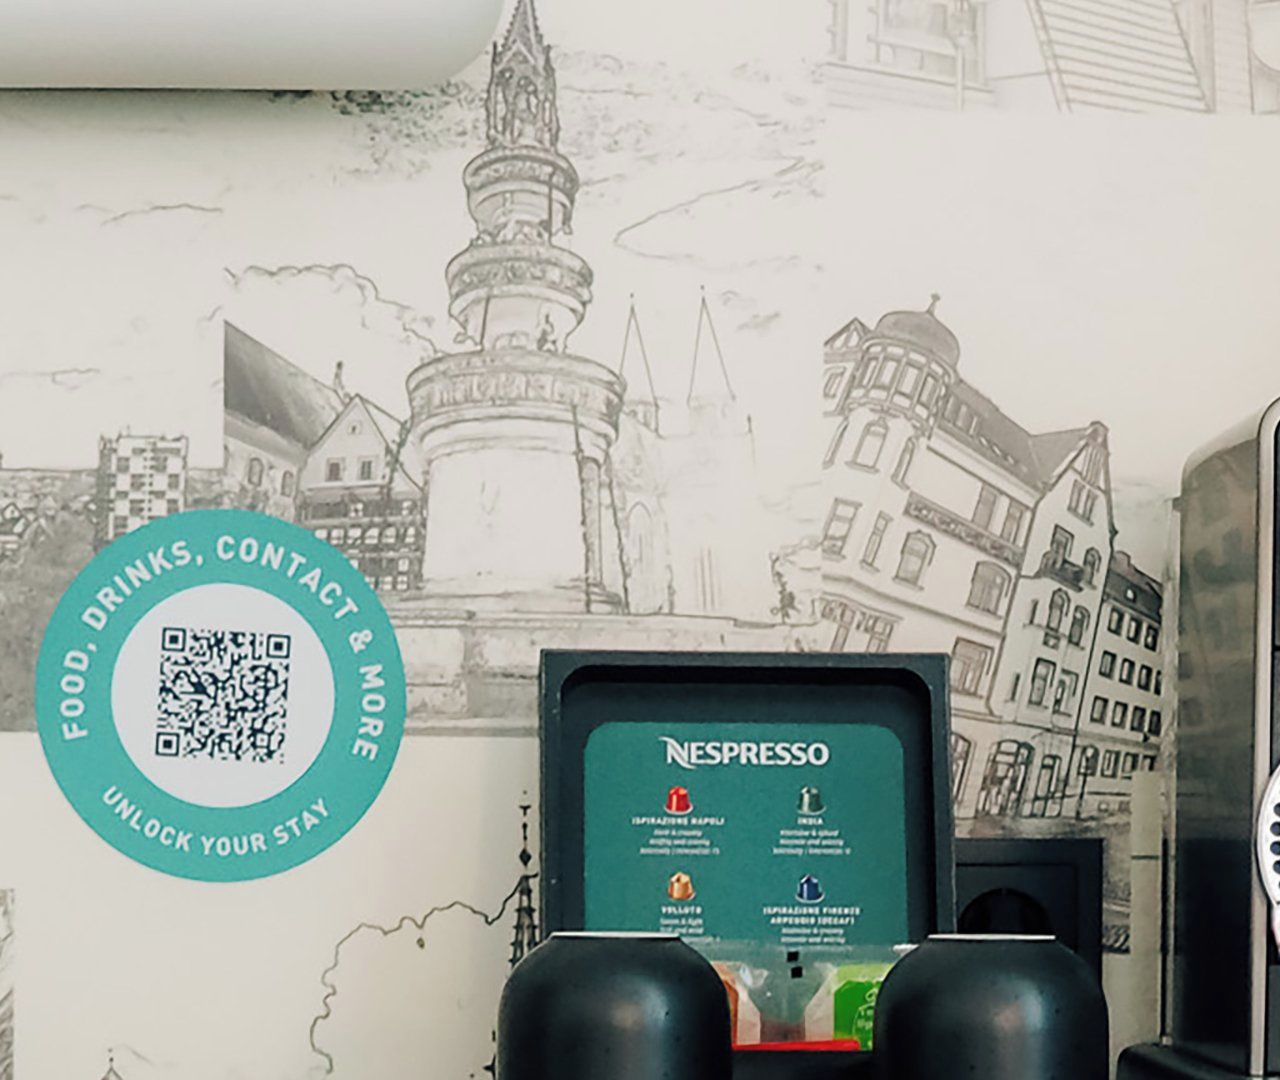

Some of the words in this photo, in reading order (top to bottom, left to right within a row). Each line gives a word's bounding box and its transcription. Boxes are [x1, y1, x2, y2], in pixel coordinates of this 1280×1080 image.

[81, 538, 204, 632] DRINKS,
[216, 534, 360, 620] CONTACT
[348, 628, 374, 653] &
[59, 642, 99, 741] FOOD,
[352, 664, 387, 763] MORE
[658, 735, 830, 770] NESPRESSO
[102, 786, 193, 853] UNLOCK
[200, 833, 269, 857] YOUR
[272, 797, 331, 847] STAY
